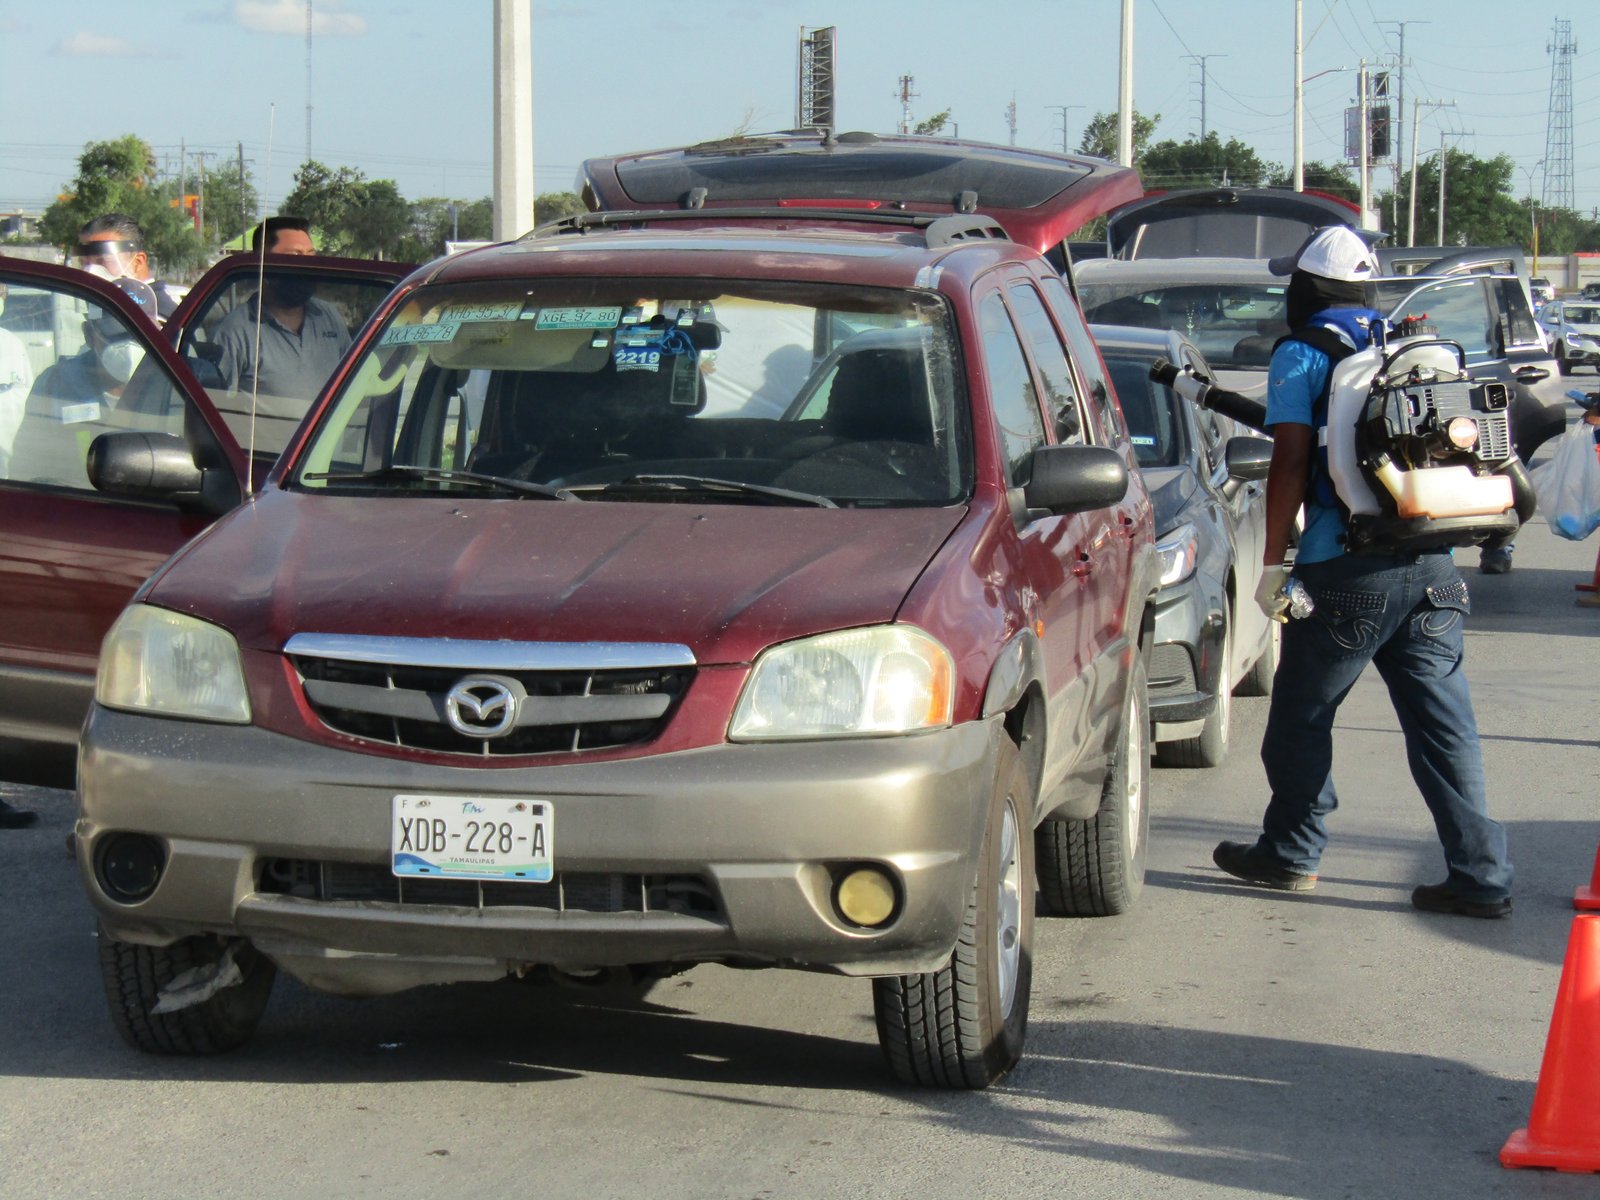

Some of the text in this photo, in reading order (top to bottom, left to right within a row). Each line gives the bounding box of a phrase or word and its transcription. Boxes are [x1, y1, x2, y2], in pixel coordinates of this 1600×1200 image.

[616, 350, 660, 364] 2219
[402, 800, 408, 808] F
[400, 817, 546, 858] XDB-228-A
[449, 857, 496, 865] TAMAULIPAS
